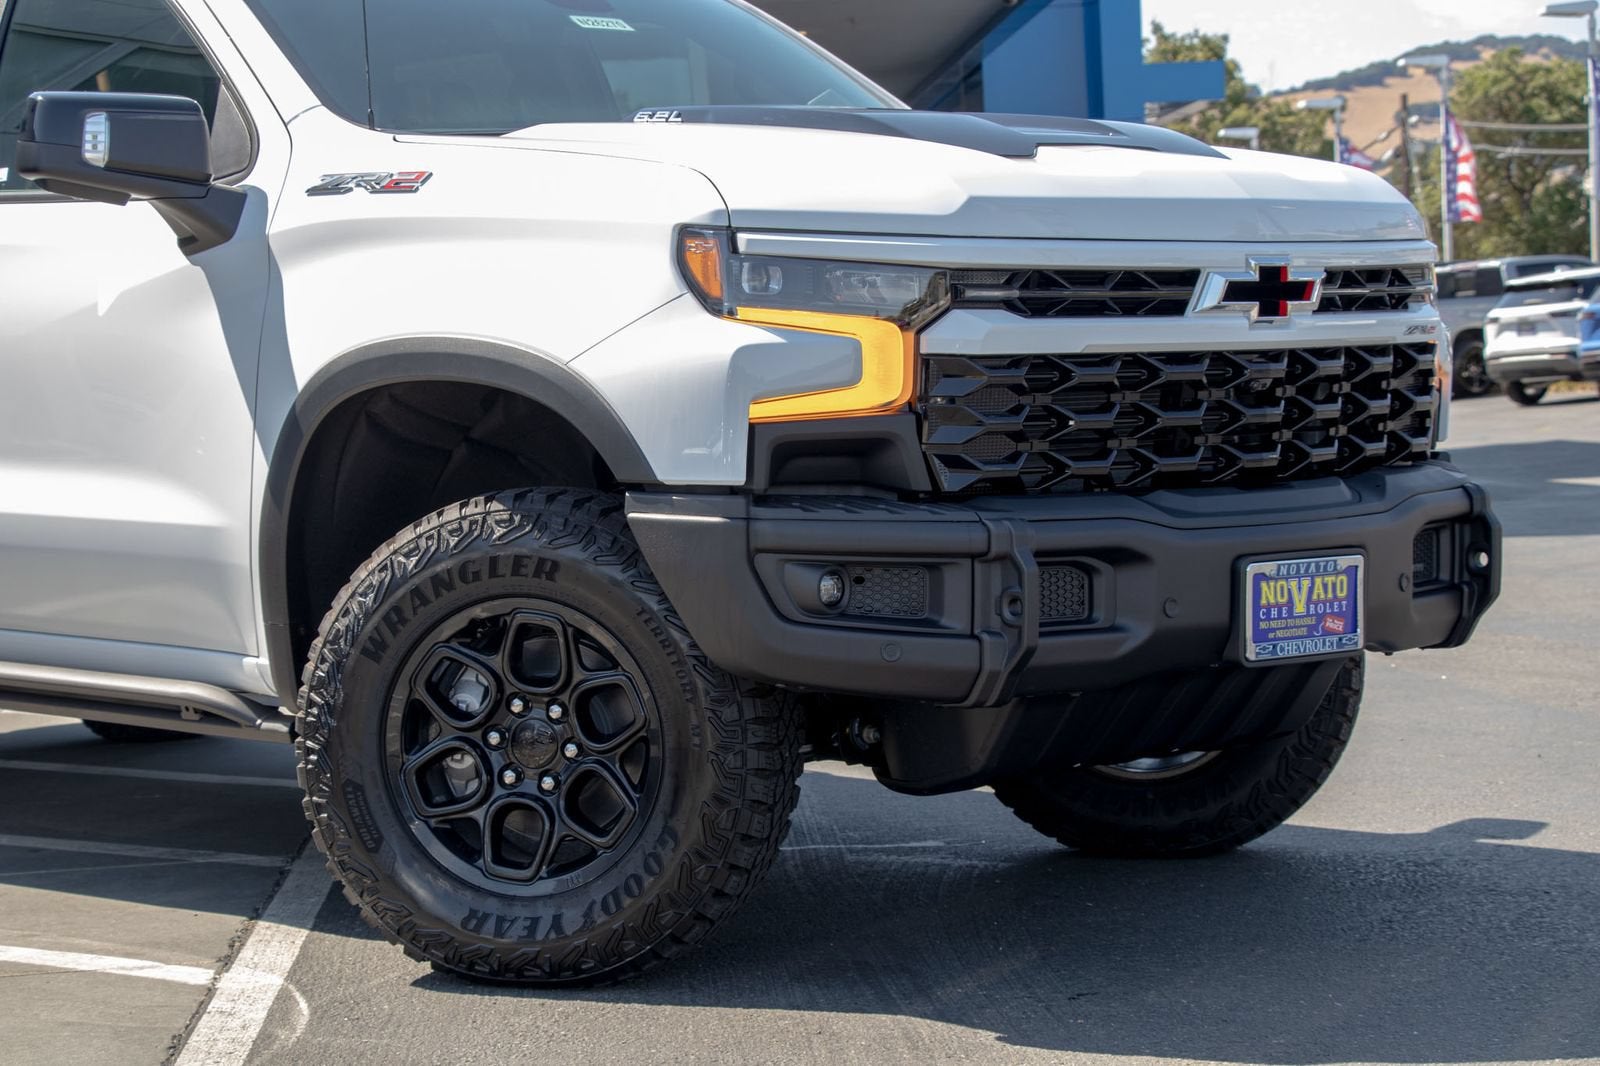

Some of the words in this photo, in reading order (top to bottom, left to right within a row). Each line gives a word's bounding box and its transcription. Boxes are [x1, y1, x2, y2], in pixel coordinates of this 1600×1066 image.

[305, 171, 433, 196] ZR2
[1279, 561, 1335, 576] NOVATO
[1260, 574, 1347, 616] NOVATO
[359, 554, 562, 666] WRANGLER
[1259, 620, 1269, 629] NO
[1269, 619, 1287, 629] NEED
[1287, 618, 1295, 627] TO
[635, 606, 697, 704] TERRITORY
[1276, 637, 1339, 656] CHEVROLET
